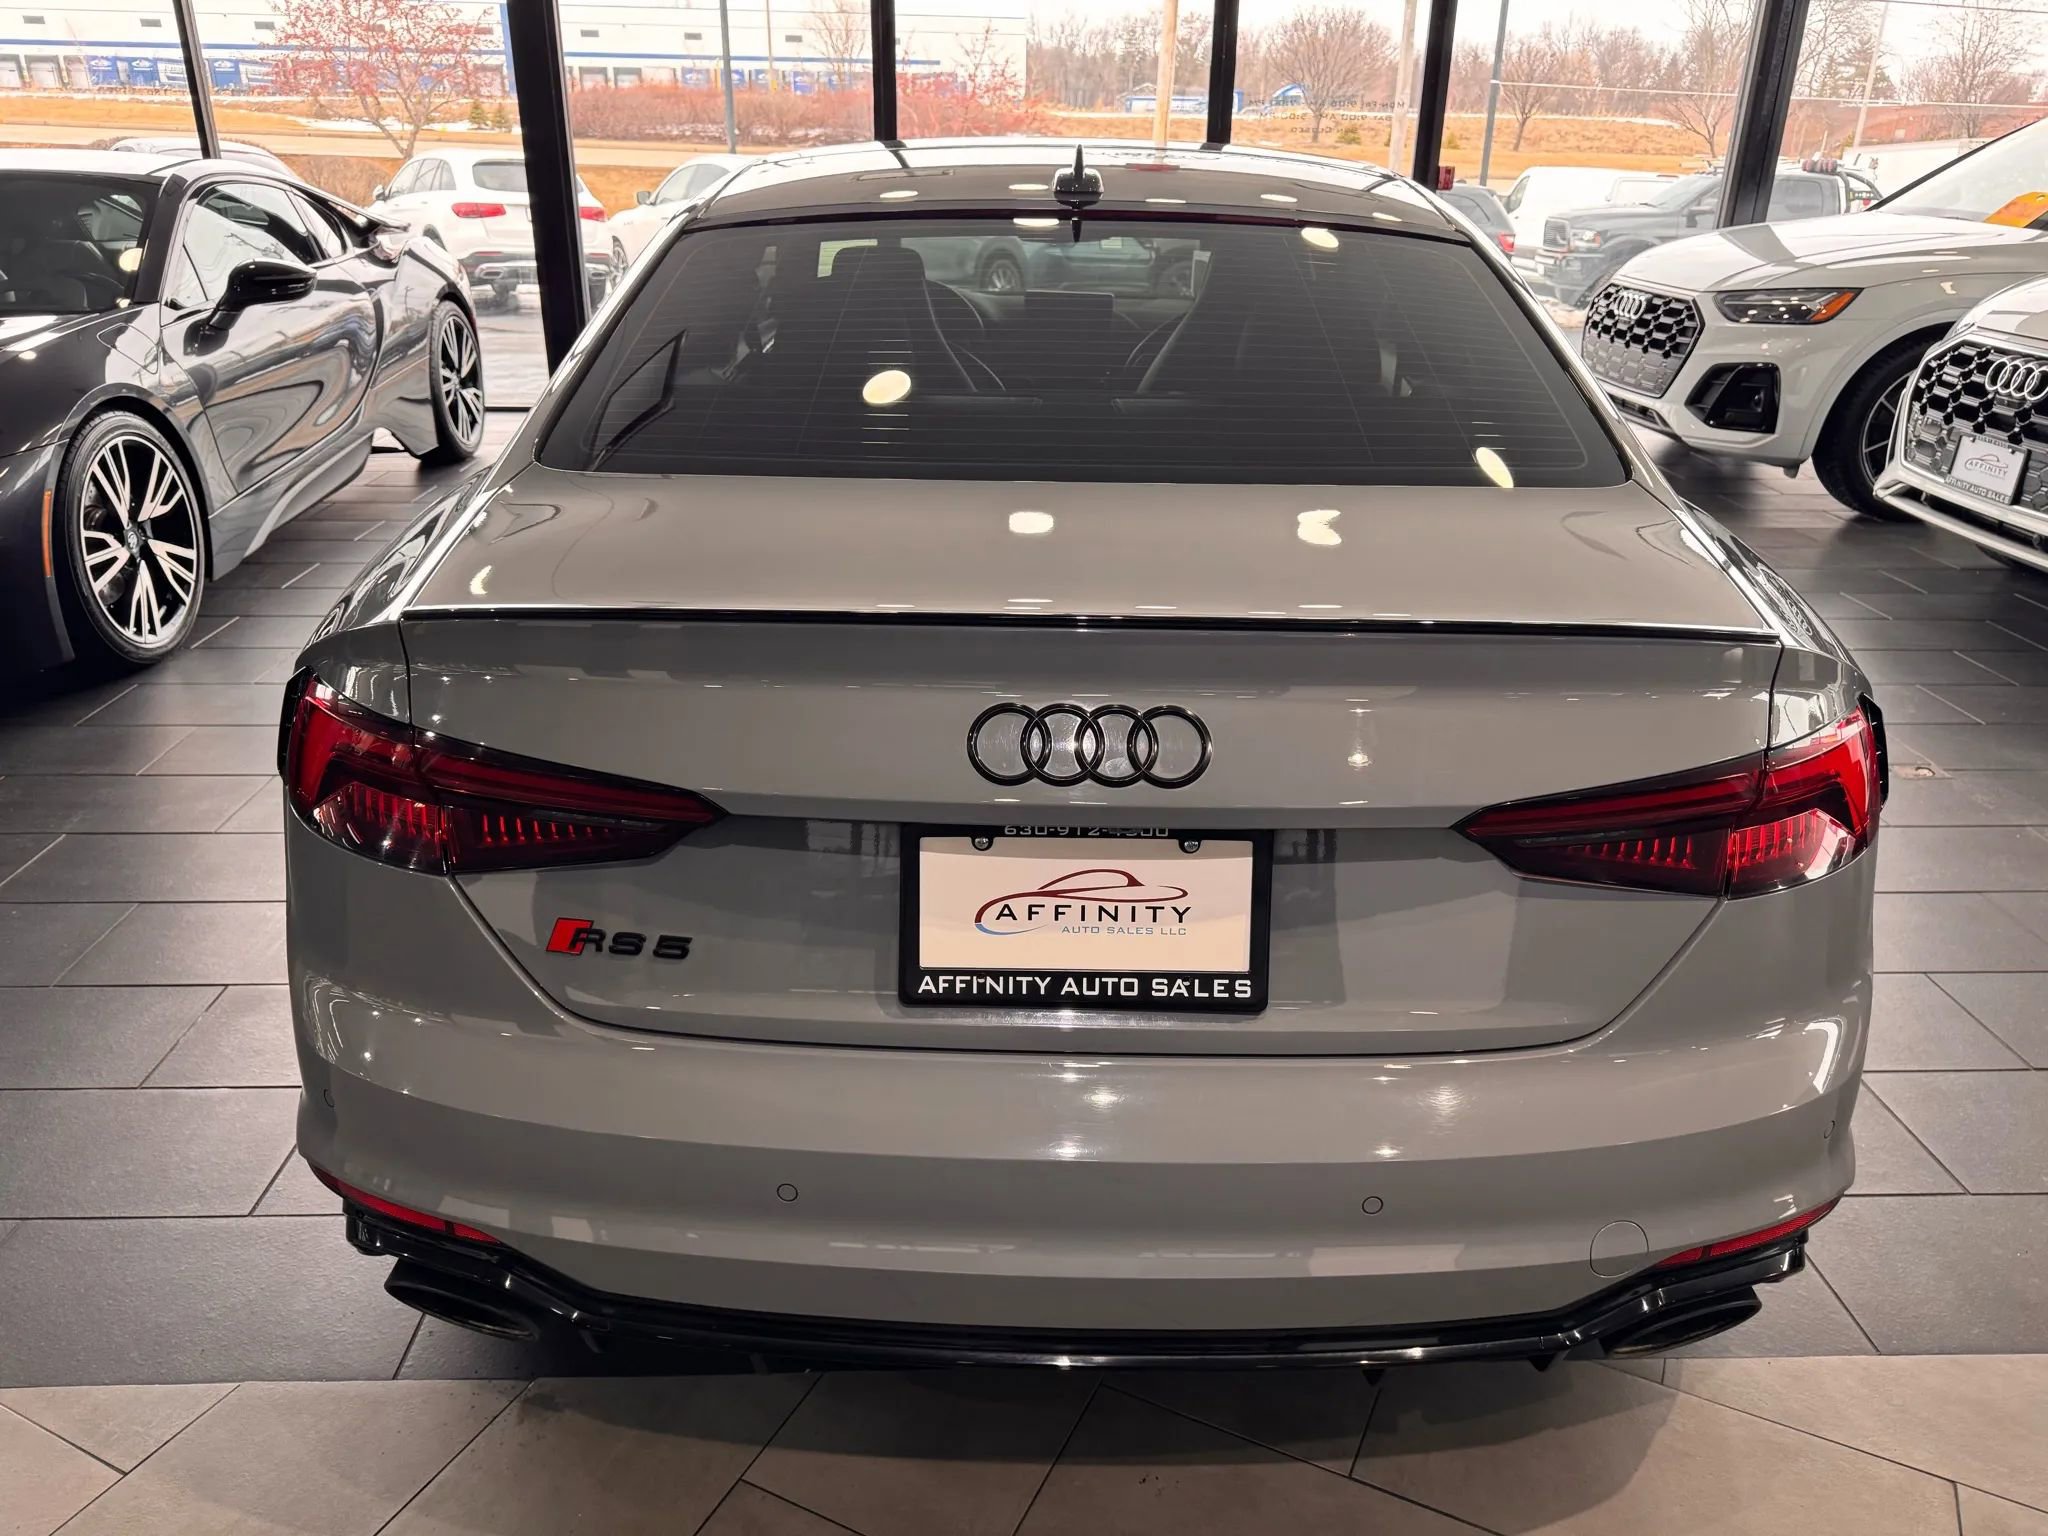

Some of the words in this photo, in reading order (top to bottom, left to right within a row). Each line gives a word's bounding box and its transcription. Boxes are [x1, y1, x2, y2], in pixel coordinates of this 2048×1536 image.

[1968, 460, 2008, 476] AFFINITY
[995, 904, 1191, 923] AFFINITY
[1061, 926, 1099, 934] AUTO
[1107, 926, 1153, 935] SALES
[1160, 927, 1186, 935] LLC
[918, 975, 1051, 995] AFFINITY
[1060, 976, 1139, 997] AUTO
[1151, 978, 1251, 998] SALES
